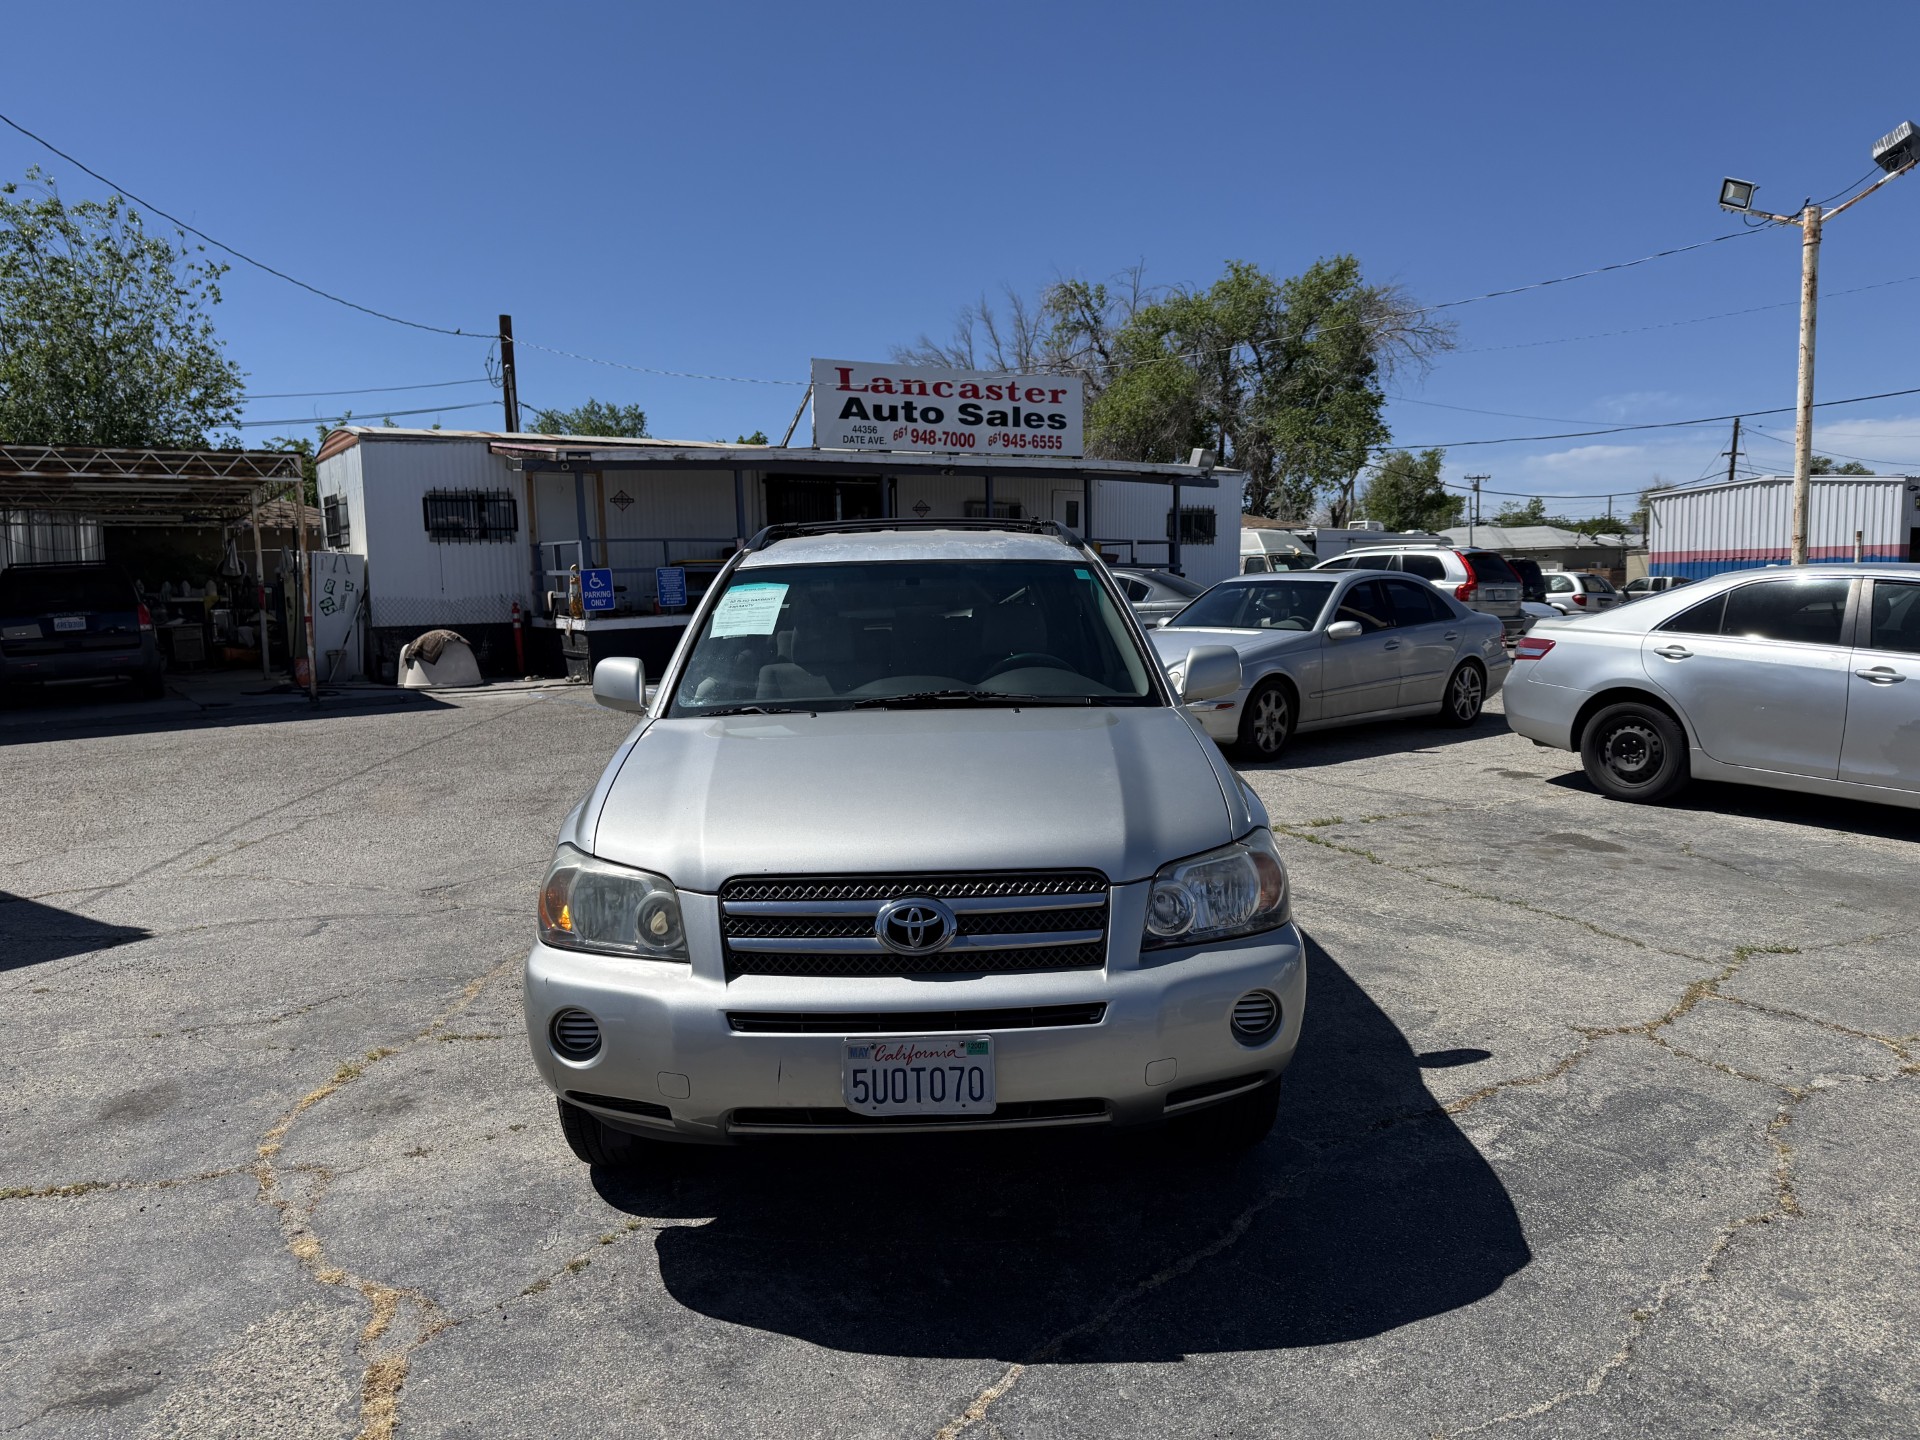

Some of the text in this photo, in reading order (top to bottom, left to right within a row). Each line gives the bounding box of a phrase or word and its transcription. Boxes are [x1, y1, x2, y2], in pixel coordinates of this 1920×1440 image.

[834, 367, 1068, 404] Lancaster
[838, 397, 1067, 430] Auto Sales
[852, 425, 878, 434] 44356
[893, 424, 976, 449] 661 948-7000
[842, 435, 887, 445] DATE AVE.
[988, 430, 1062, 450] 661 945-6555
[584, 590, 611, 599] PARKING
[850, 1047, 868, 1058] MAY
[874, 1044, 967, 1066] California
